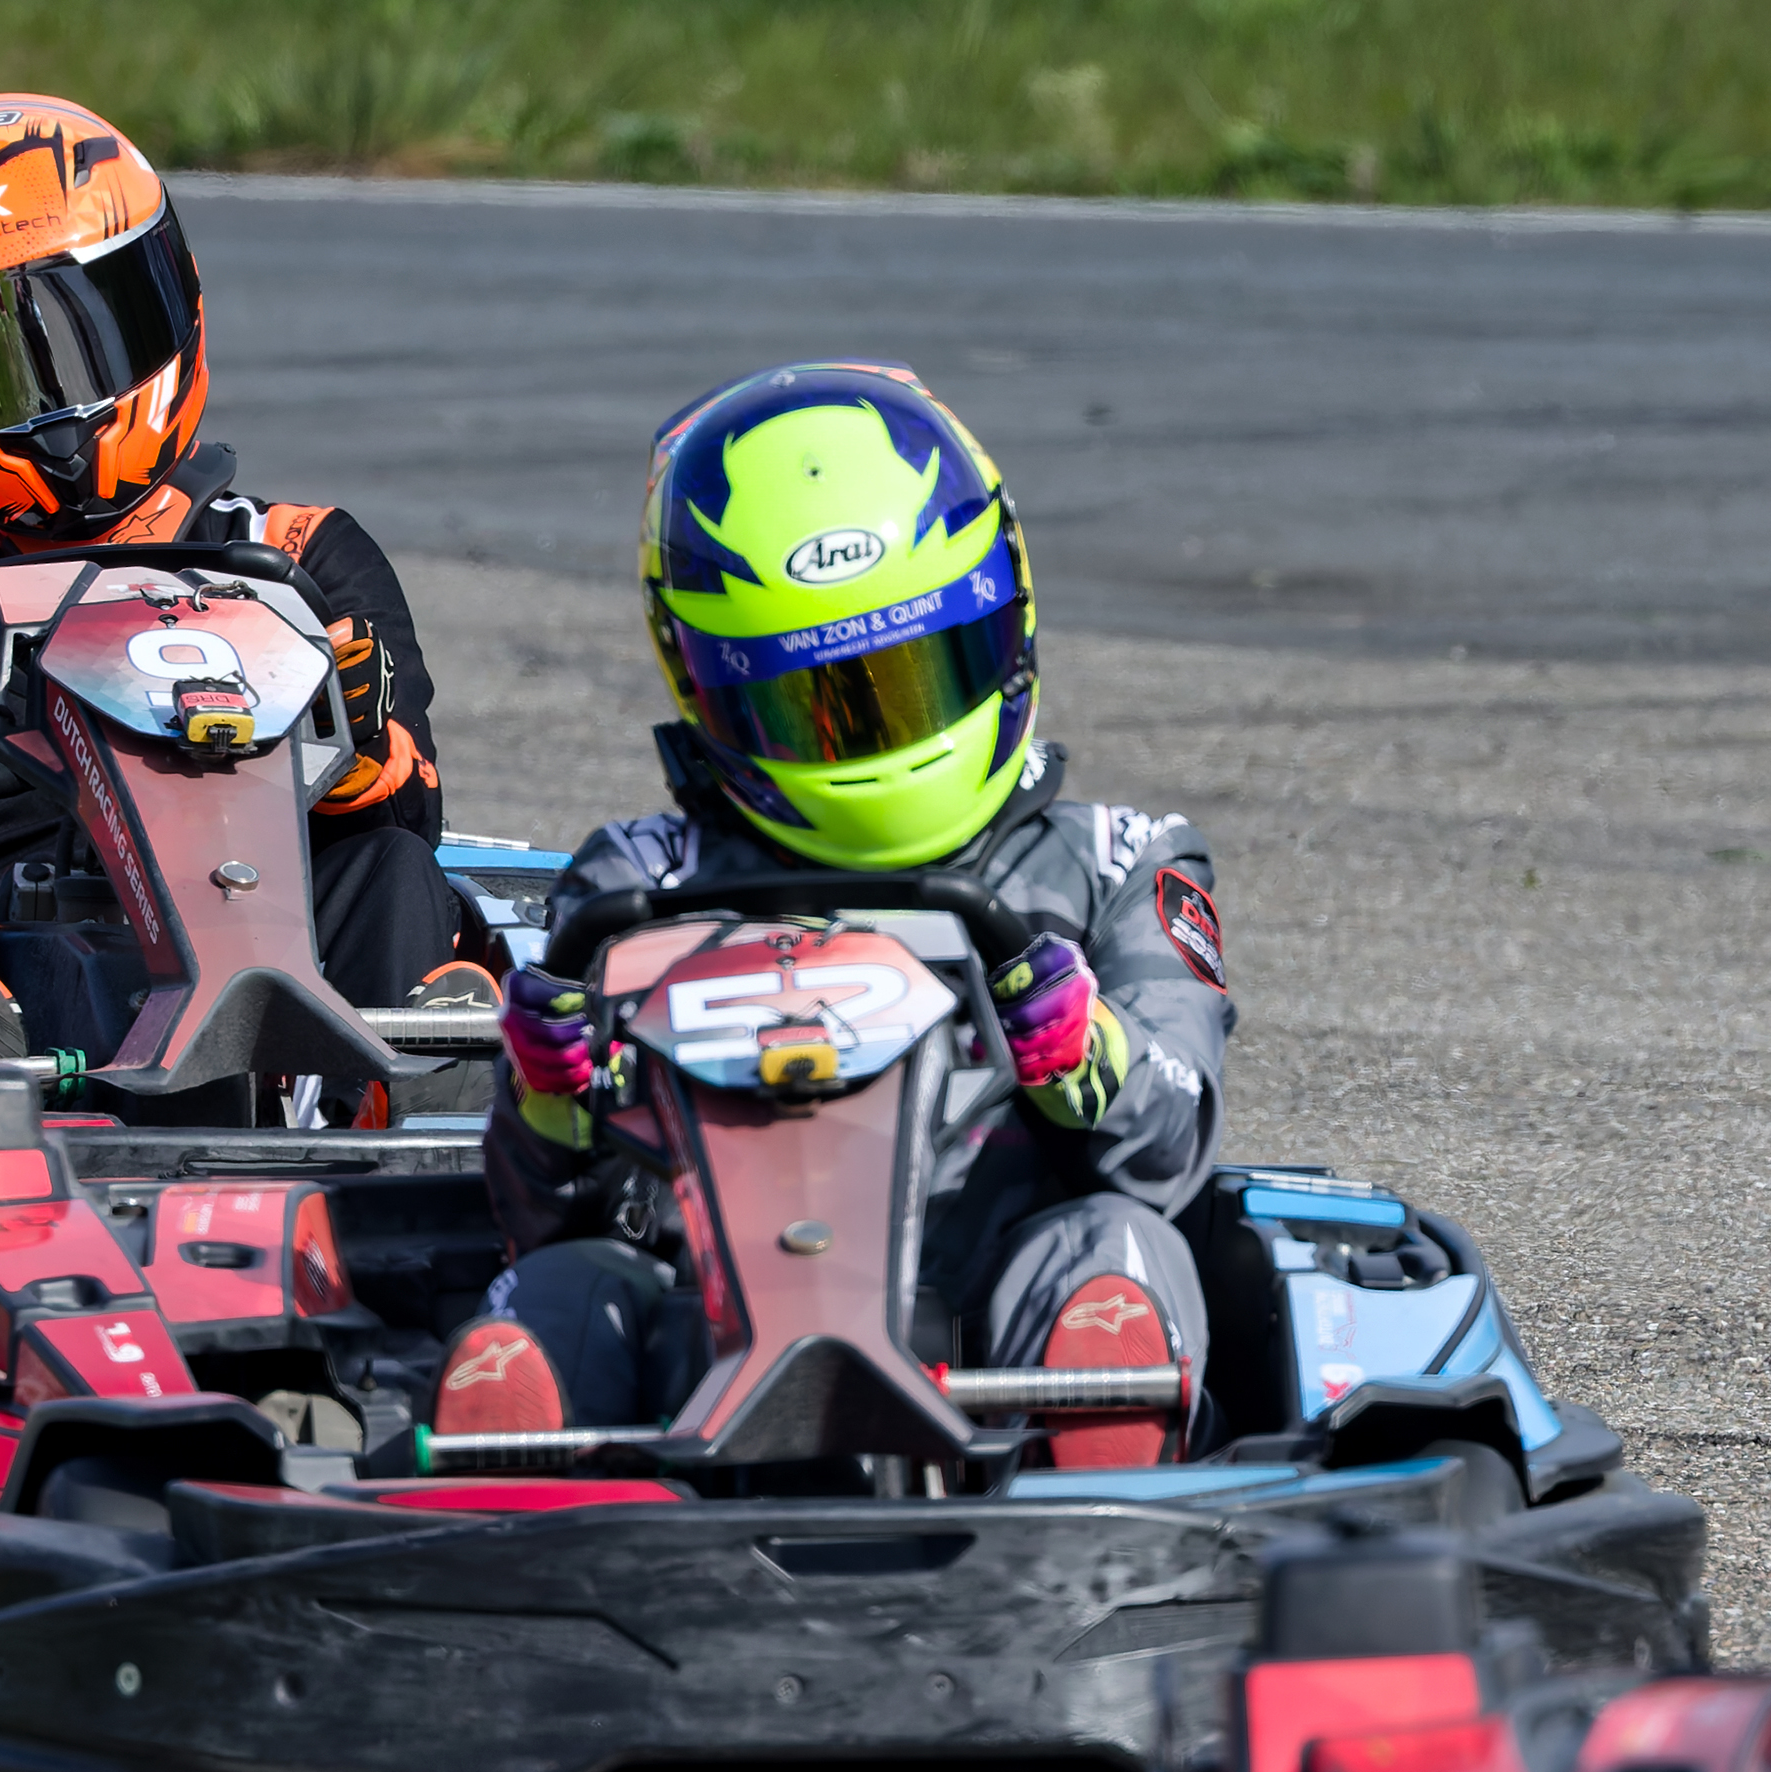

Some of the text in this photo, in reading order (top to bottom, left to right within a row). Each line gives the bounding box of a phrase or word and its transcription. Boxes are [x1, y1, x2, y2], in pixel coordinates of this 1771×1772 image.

[281, 513, 311, 556] parco
[791, 532, 873, 579] Arai
[778, 629, 821, 653] VAN
[823, 617, 867, 644] ZON
[870, 611, 887, 632] &
[888, 591, 943, 625] QUINT
[55, 696, 159, 945] DUTCH RACING SERIES
[669, 963, 908, 1063] 52
